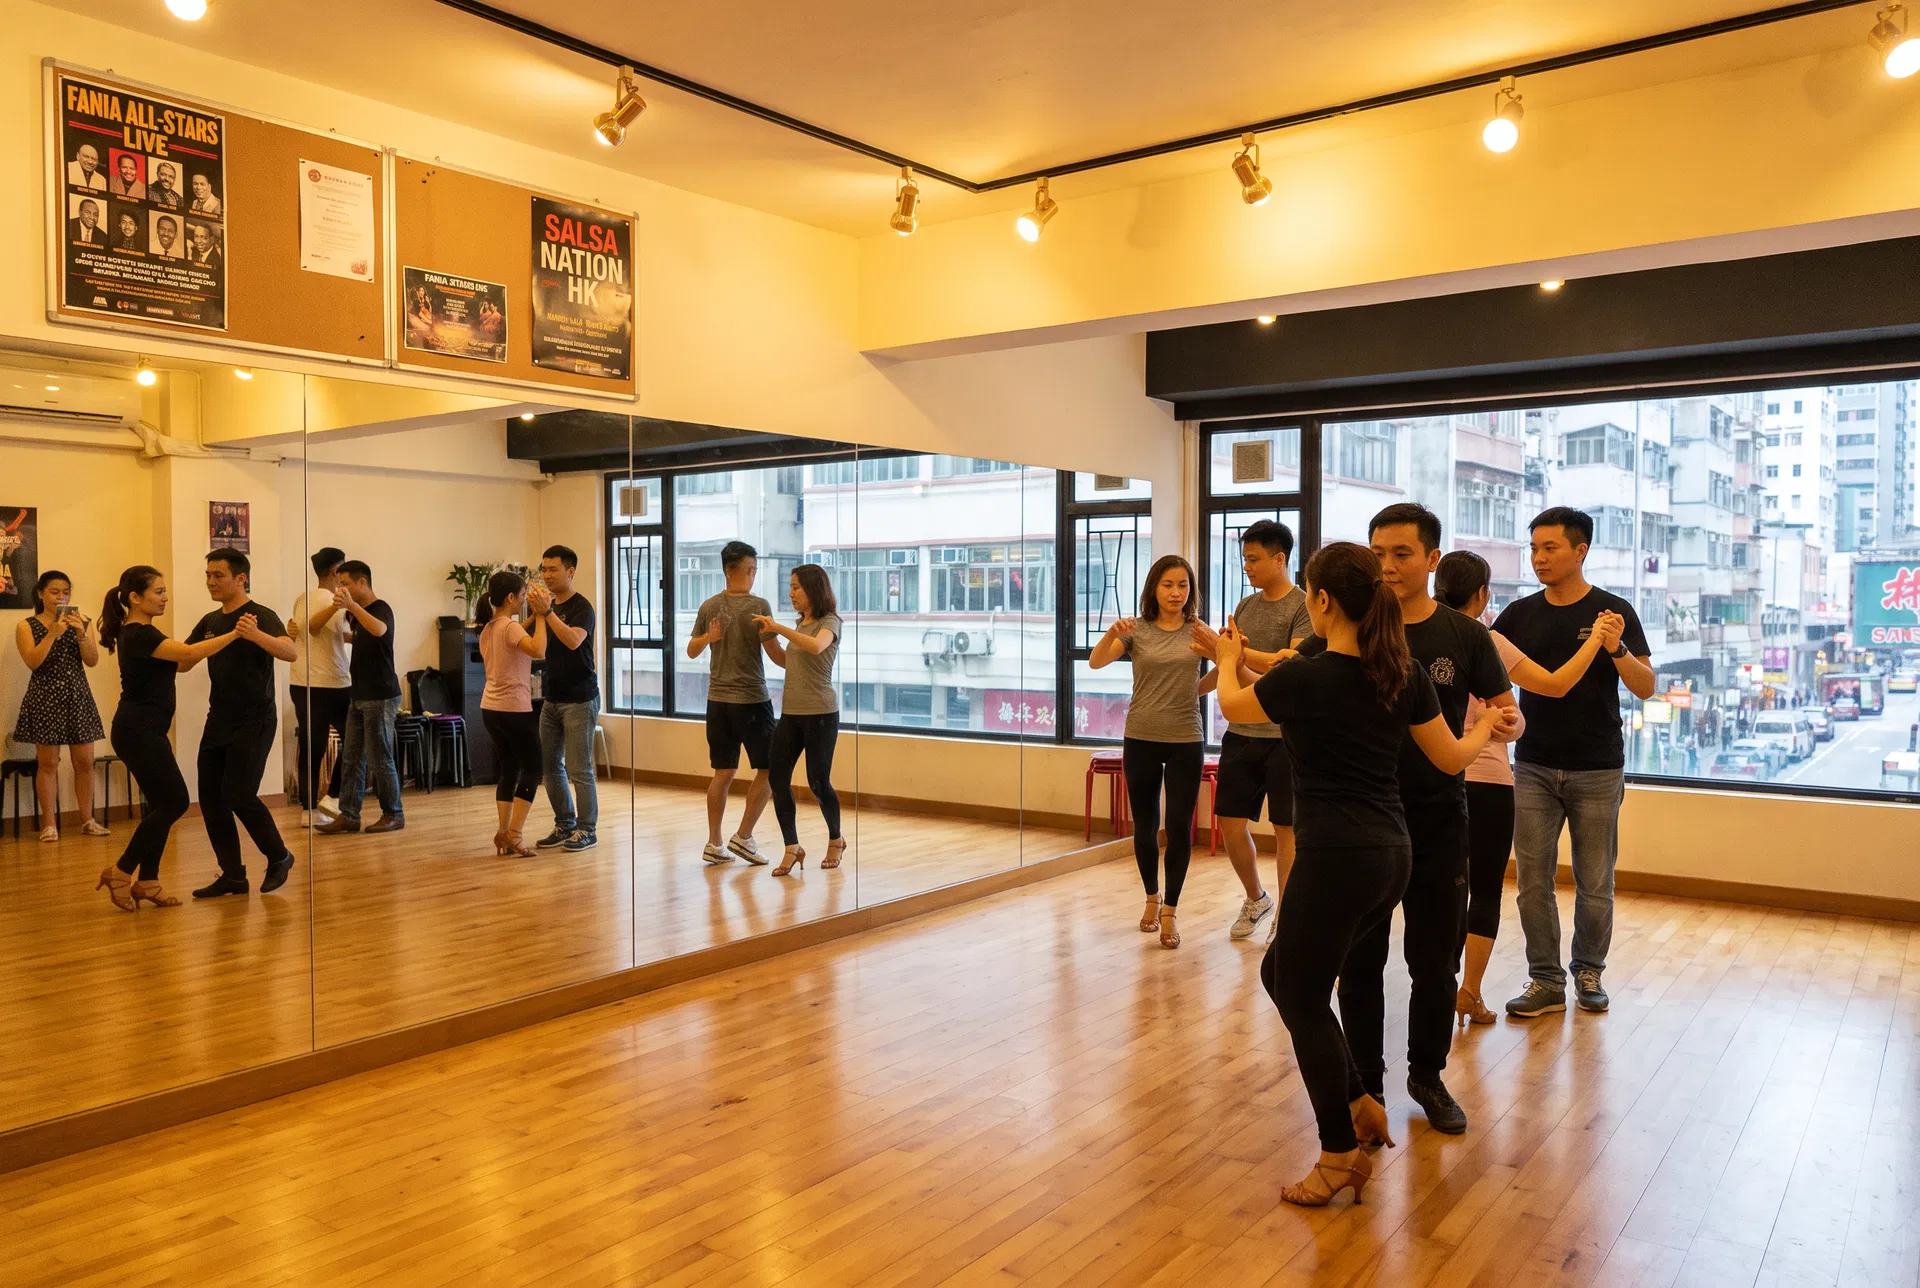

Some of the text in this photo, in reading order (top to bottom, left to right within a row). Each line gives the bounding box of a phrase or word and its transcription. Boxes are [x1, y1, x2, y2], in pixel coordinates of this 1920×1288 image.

[67, 84, 219, 145] FANIA ALL-STARS
[123, 126, 169, 157] LIVE
[545, 213, 619, 256] SALSA
[424, 273, 448, 286] FANIA
[541, 241, 623, 285] NATION
[568, 275, 600, 308] HK
